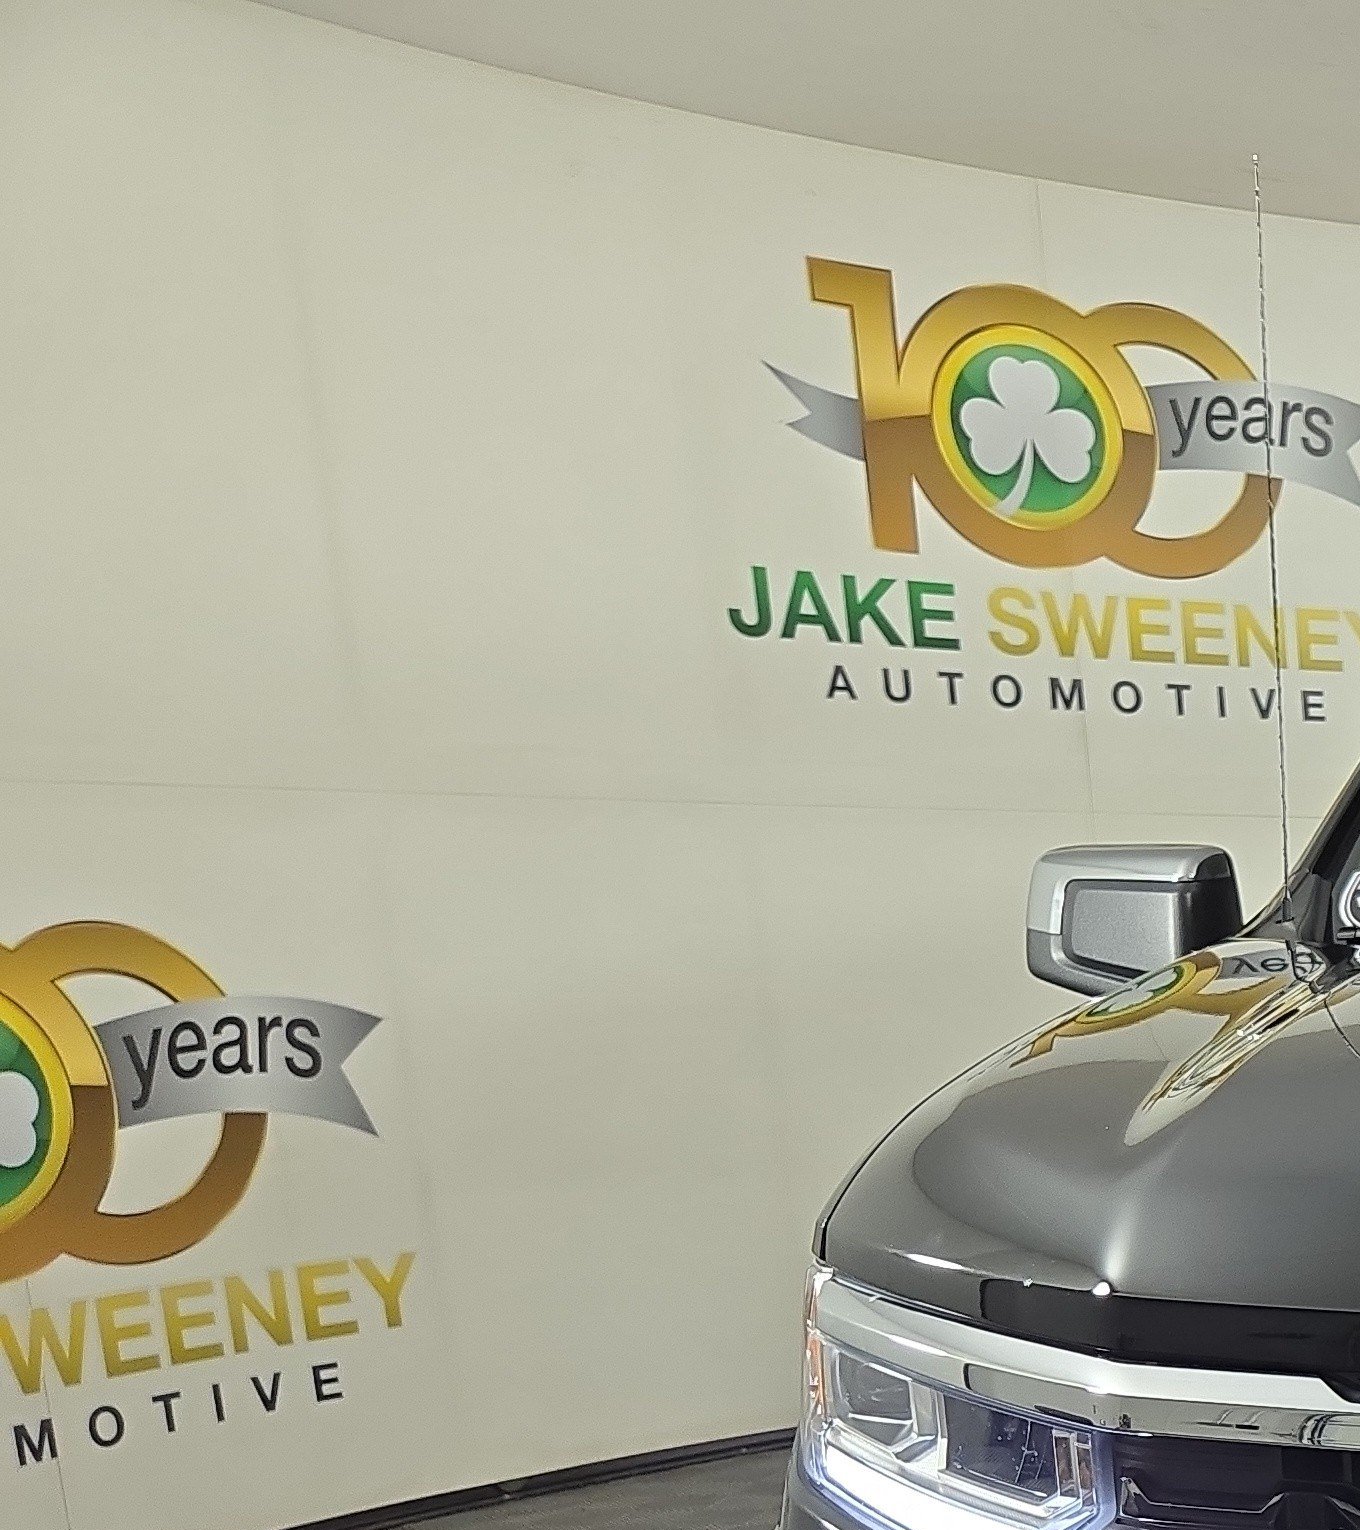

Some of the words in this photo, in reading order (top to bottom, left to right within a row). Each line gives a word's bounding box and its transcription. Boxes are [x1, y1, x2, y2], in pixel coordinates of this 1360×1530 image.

[1168, 392, 1336, 458] years
[728, 566, 961, 650] JAKE
[826, 664, 1326, 722] AUTOMOTIVE
[122, 1014, 323, 1109] years
[0, 1252, 416, 1395] WEENEY
[13, 1362, 344, 1467] MOTIVE
